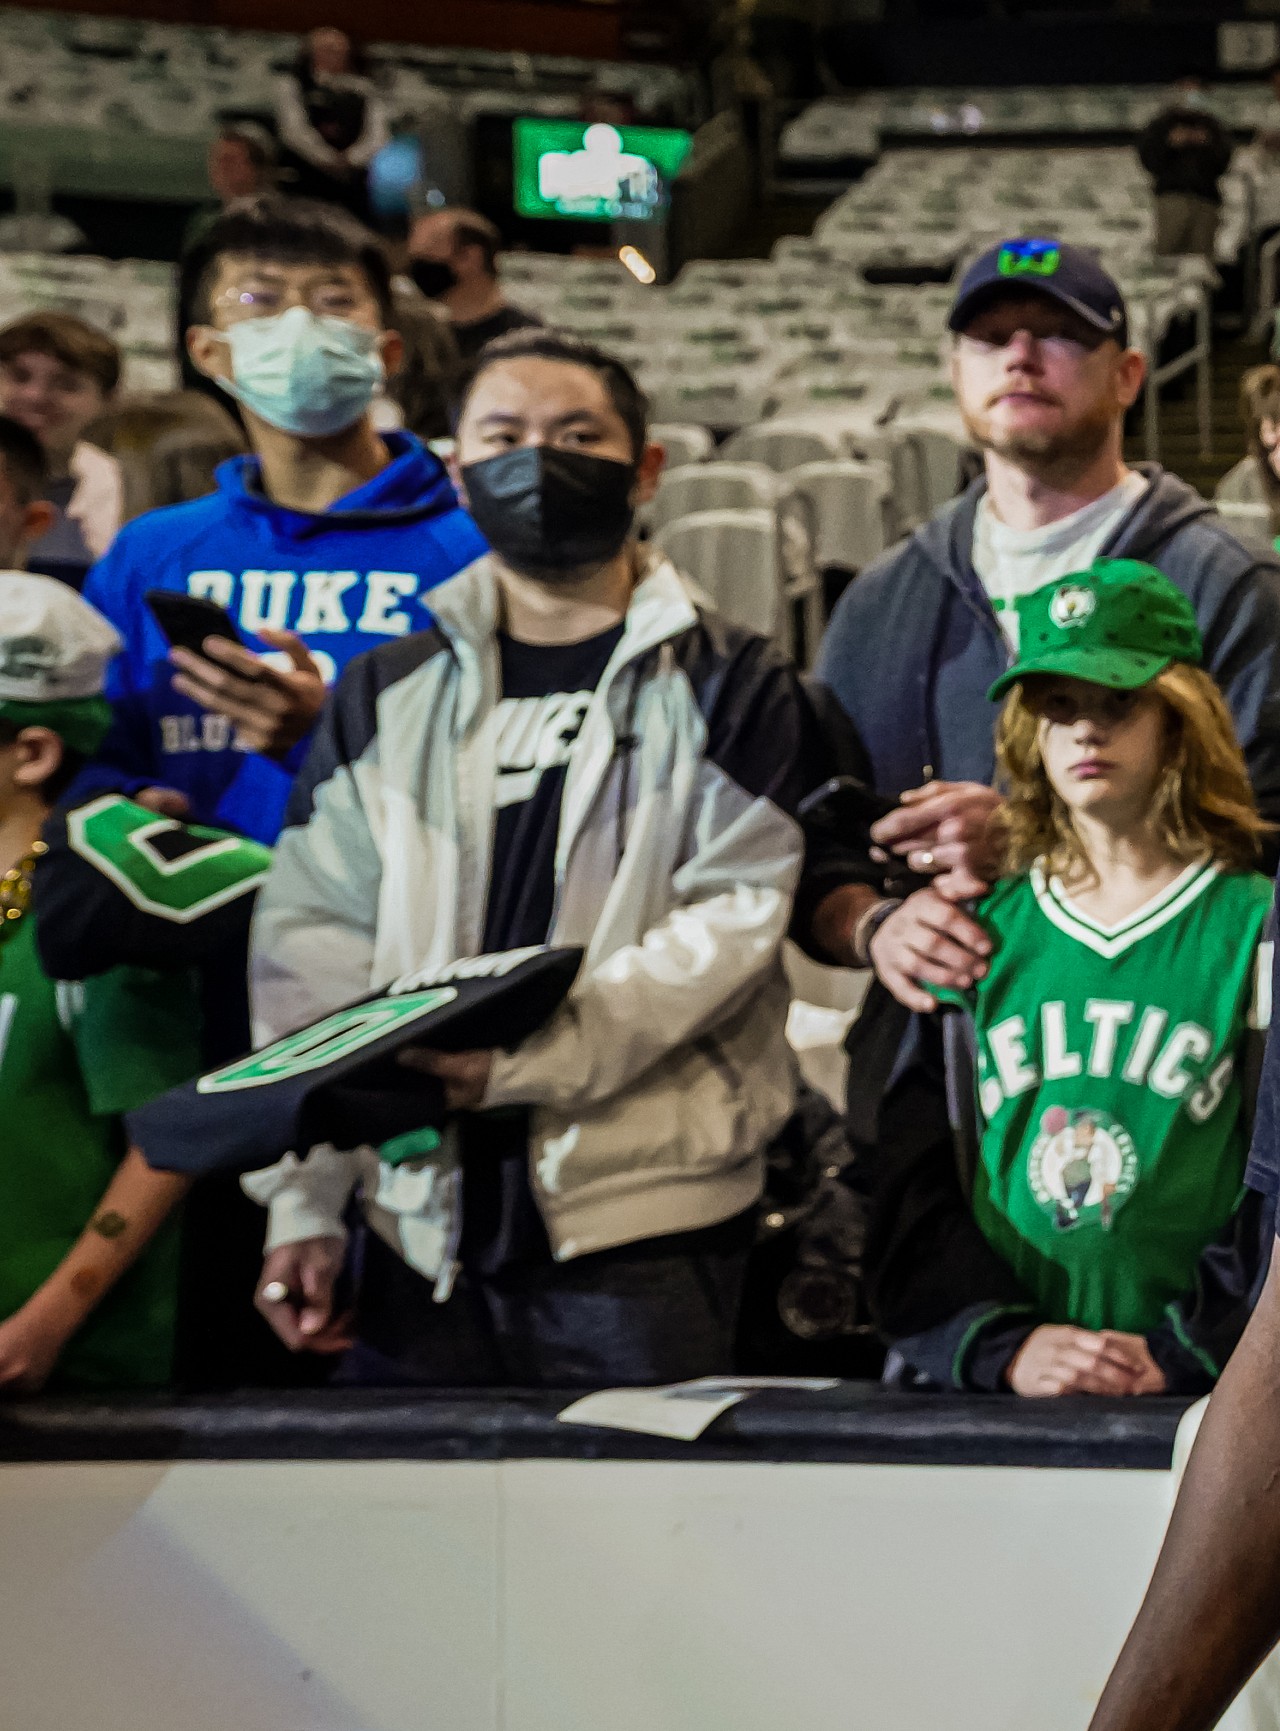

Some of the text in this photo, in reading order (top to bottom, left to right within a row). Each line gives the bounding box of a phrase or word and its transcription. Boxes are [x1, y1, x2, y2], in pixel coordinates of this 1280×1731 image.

[187, 569, 419, 635] DUKE
[160, 715, 253, 752] BLU
[979, 998, 1234, 1122] ELTICS
